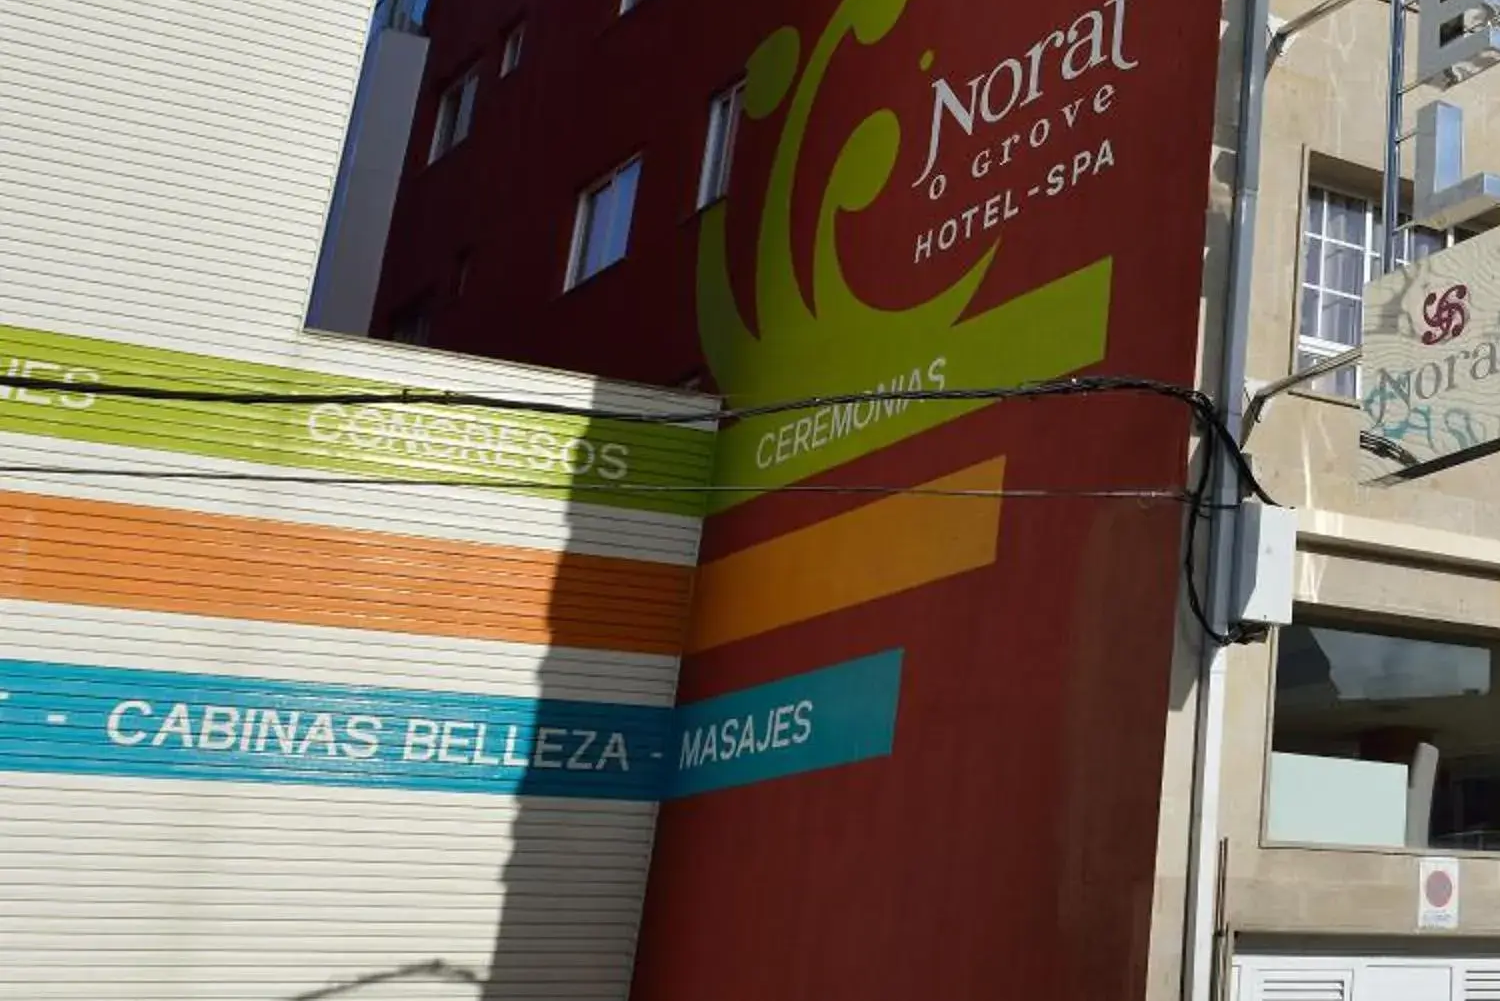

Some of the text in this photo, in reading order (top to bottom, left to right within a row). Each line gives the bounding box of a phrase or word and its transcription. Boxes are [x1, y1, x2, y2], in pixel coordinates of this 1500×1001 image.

[307, 402, 629, 480] CONGRESOS
[756, 356, 947, 469] CEREMONIAS
[106, 699, 380, 760] CABINAS
[403, 717, 630, 771] BELLEZA
[679, 699, 814, 771] MASAJES
